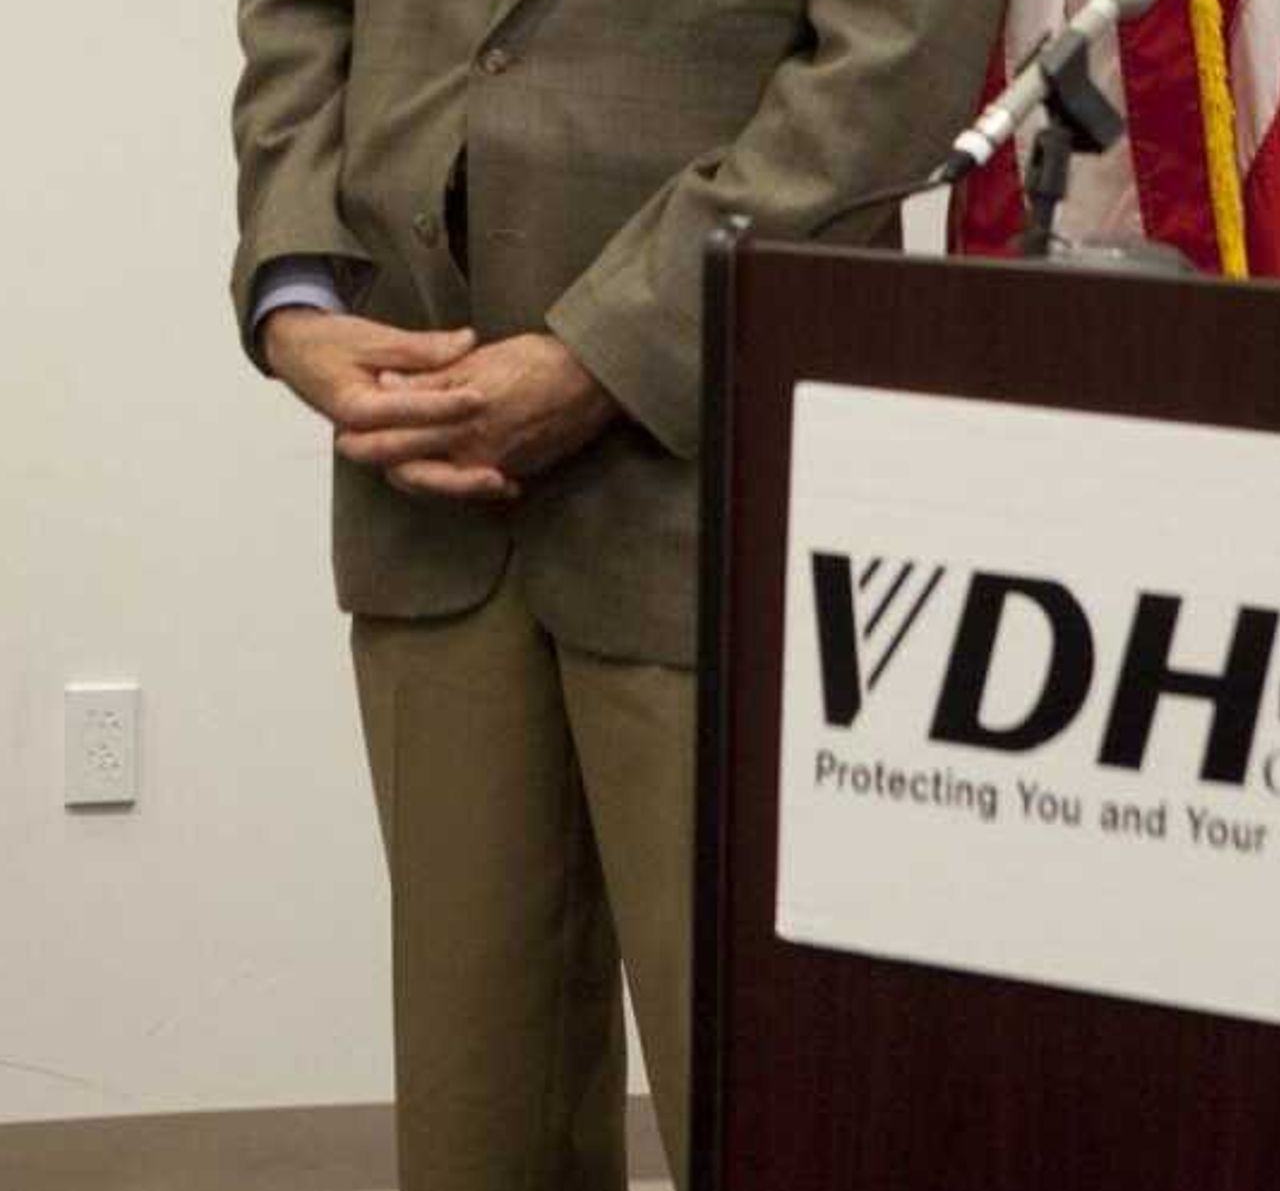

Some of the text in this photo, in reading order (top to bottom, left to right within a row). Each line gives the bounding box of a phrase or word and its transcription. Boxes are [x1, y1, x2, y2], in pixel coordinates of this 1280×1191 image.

[810, 550, 1280, 786] VDH
[815, 750, 998, 820] Protecting
[1018, 780, 1082, 828] You
[1100, 797, 1167, 838] and
[1186, 808, 1267, 853] Your
